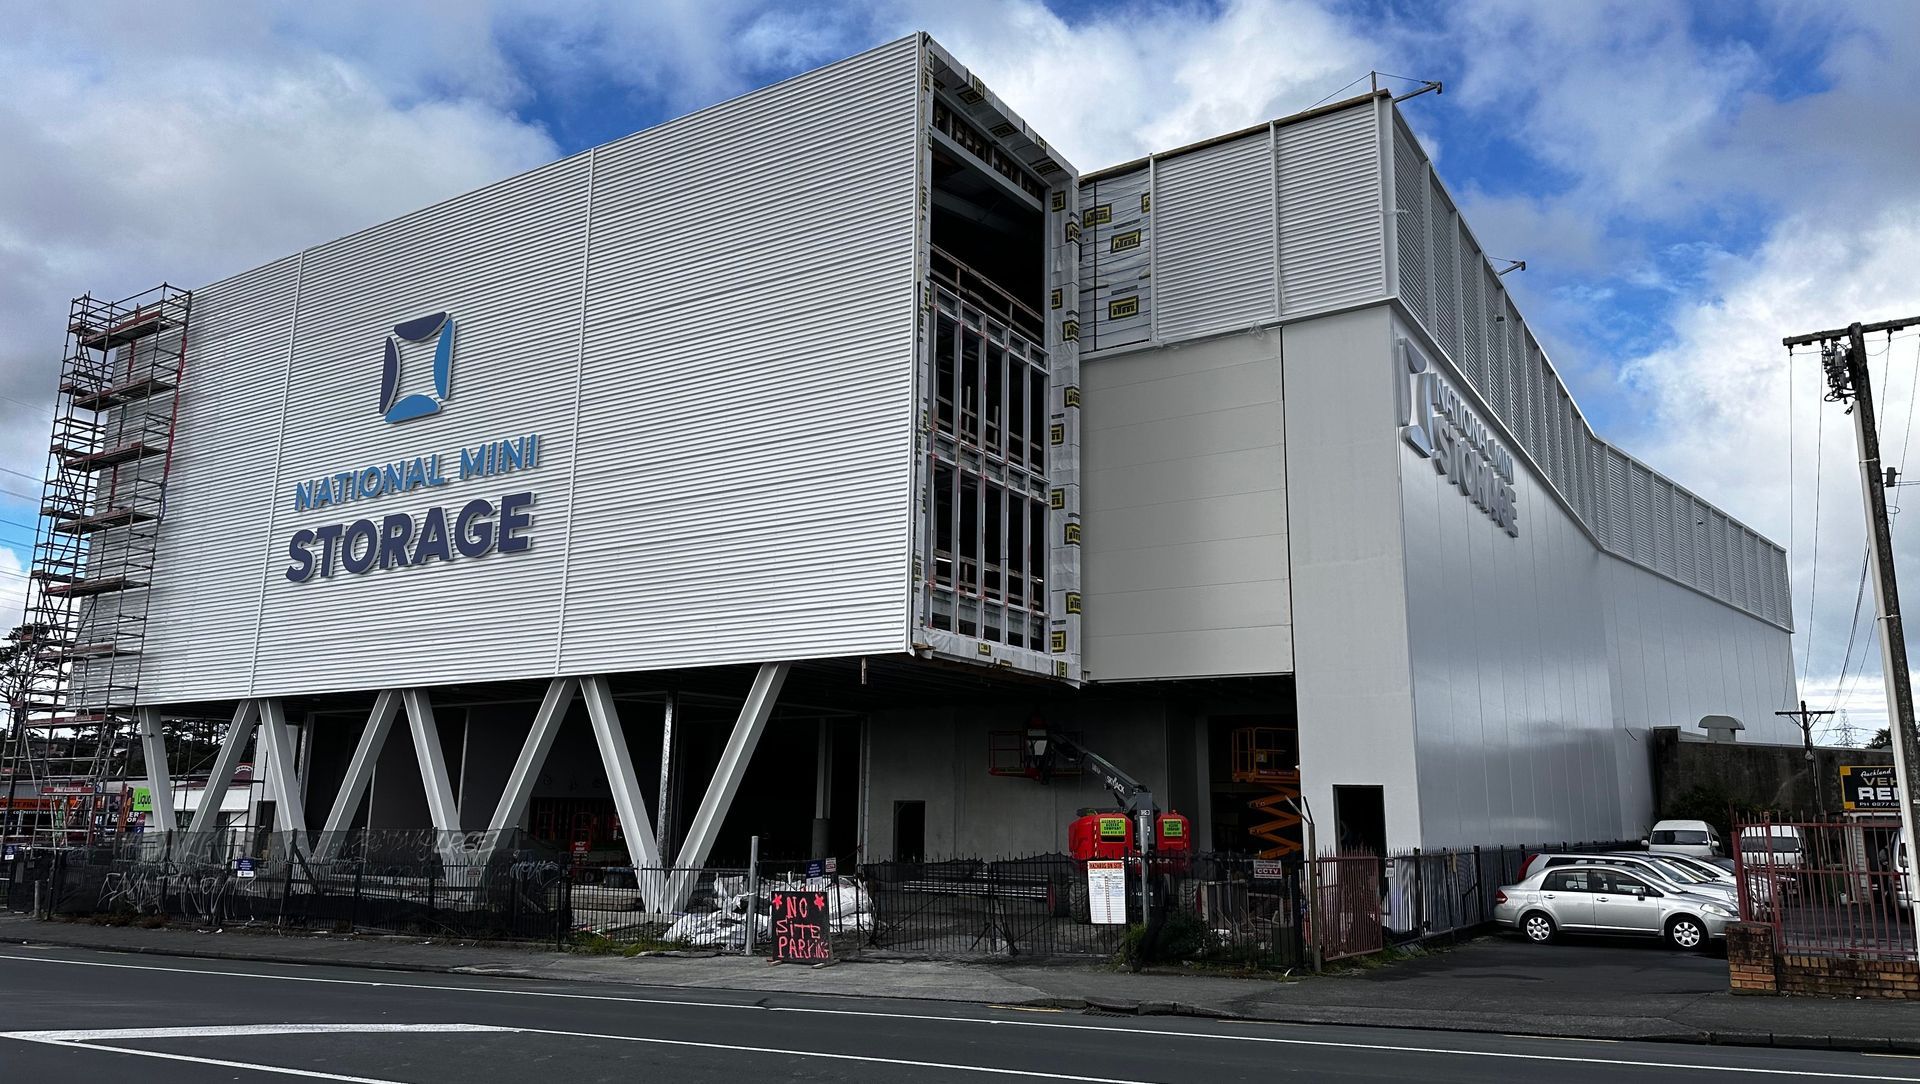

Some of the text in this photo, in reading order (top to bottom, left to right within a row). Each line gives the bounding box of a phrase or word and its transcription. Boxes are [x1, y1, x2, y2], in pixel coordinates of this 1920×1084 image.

[1431, 373, 1496, 467] NATIONAL
[295, 434, 540, 511] NATIONAL MINI
[1431, 416, 1519, 538] STORAGE
[285, 492, 537, 583] STORAGE
[1860, 768, 1892, 777] Auckland
[786, 896, 808, 918] NO
